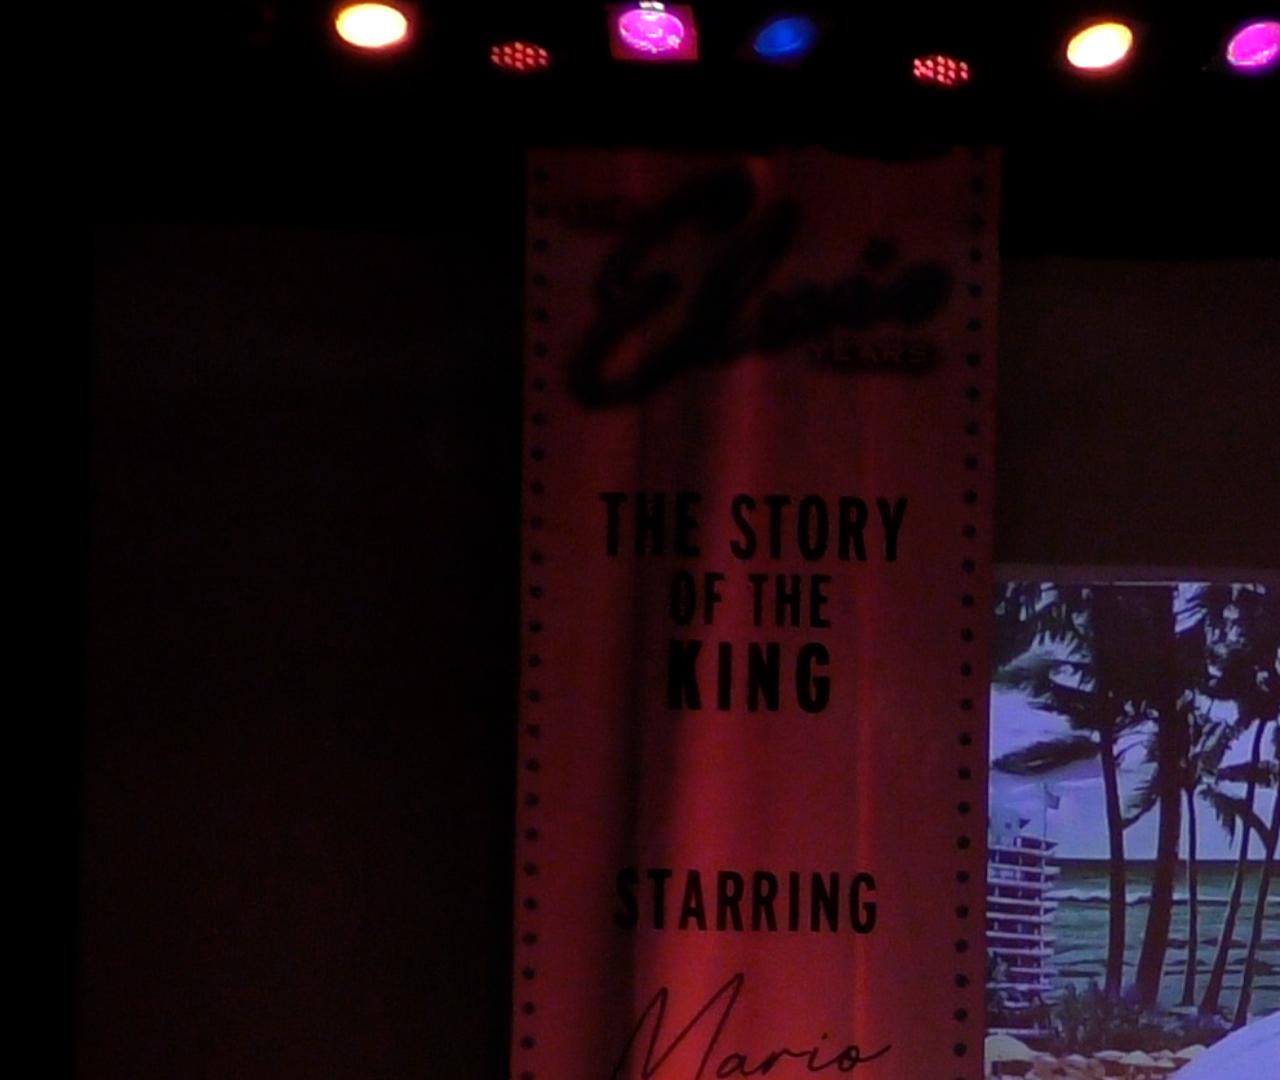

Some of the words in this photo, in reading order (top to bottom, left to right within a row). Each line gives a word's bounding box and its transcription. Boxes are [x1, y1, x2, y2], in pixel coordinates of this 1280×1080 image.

[601, 493, 700, 557] THE
[730, 495, 908, 562] STORY
[669, 571, 725, 626] OF
[748, 574, 832, 628] THE
[668, 640, 832, 714] KING
[613, 867, 878, 934] STARRING
